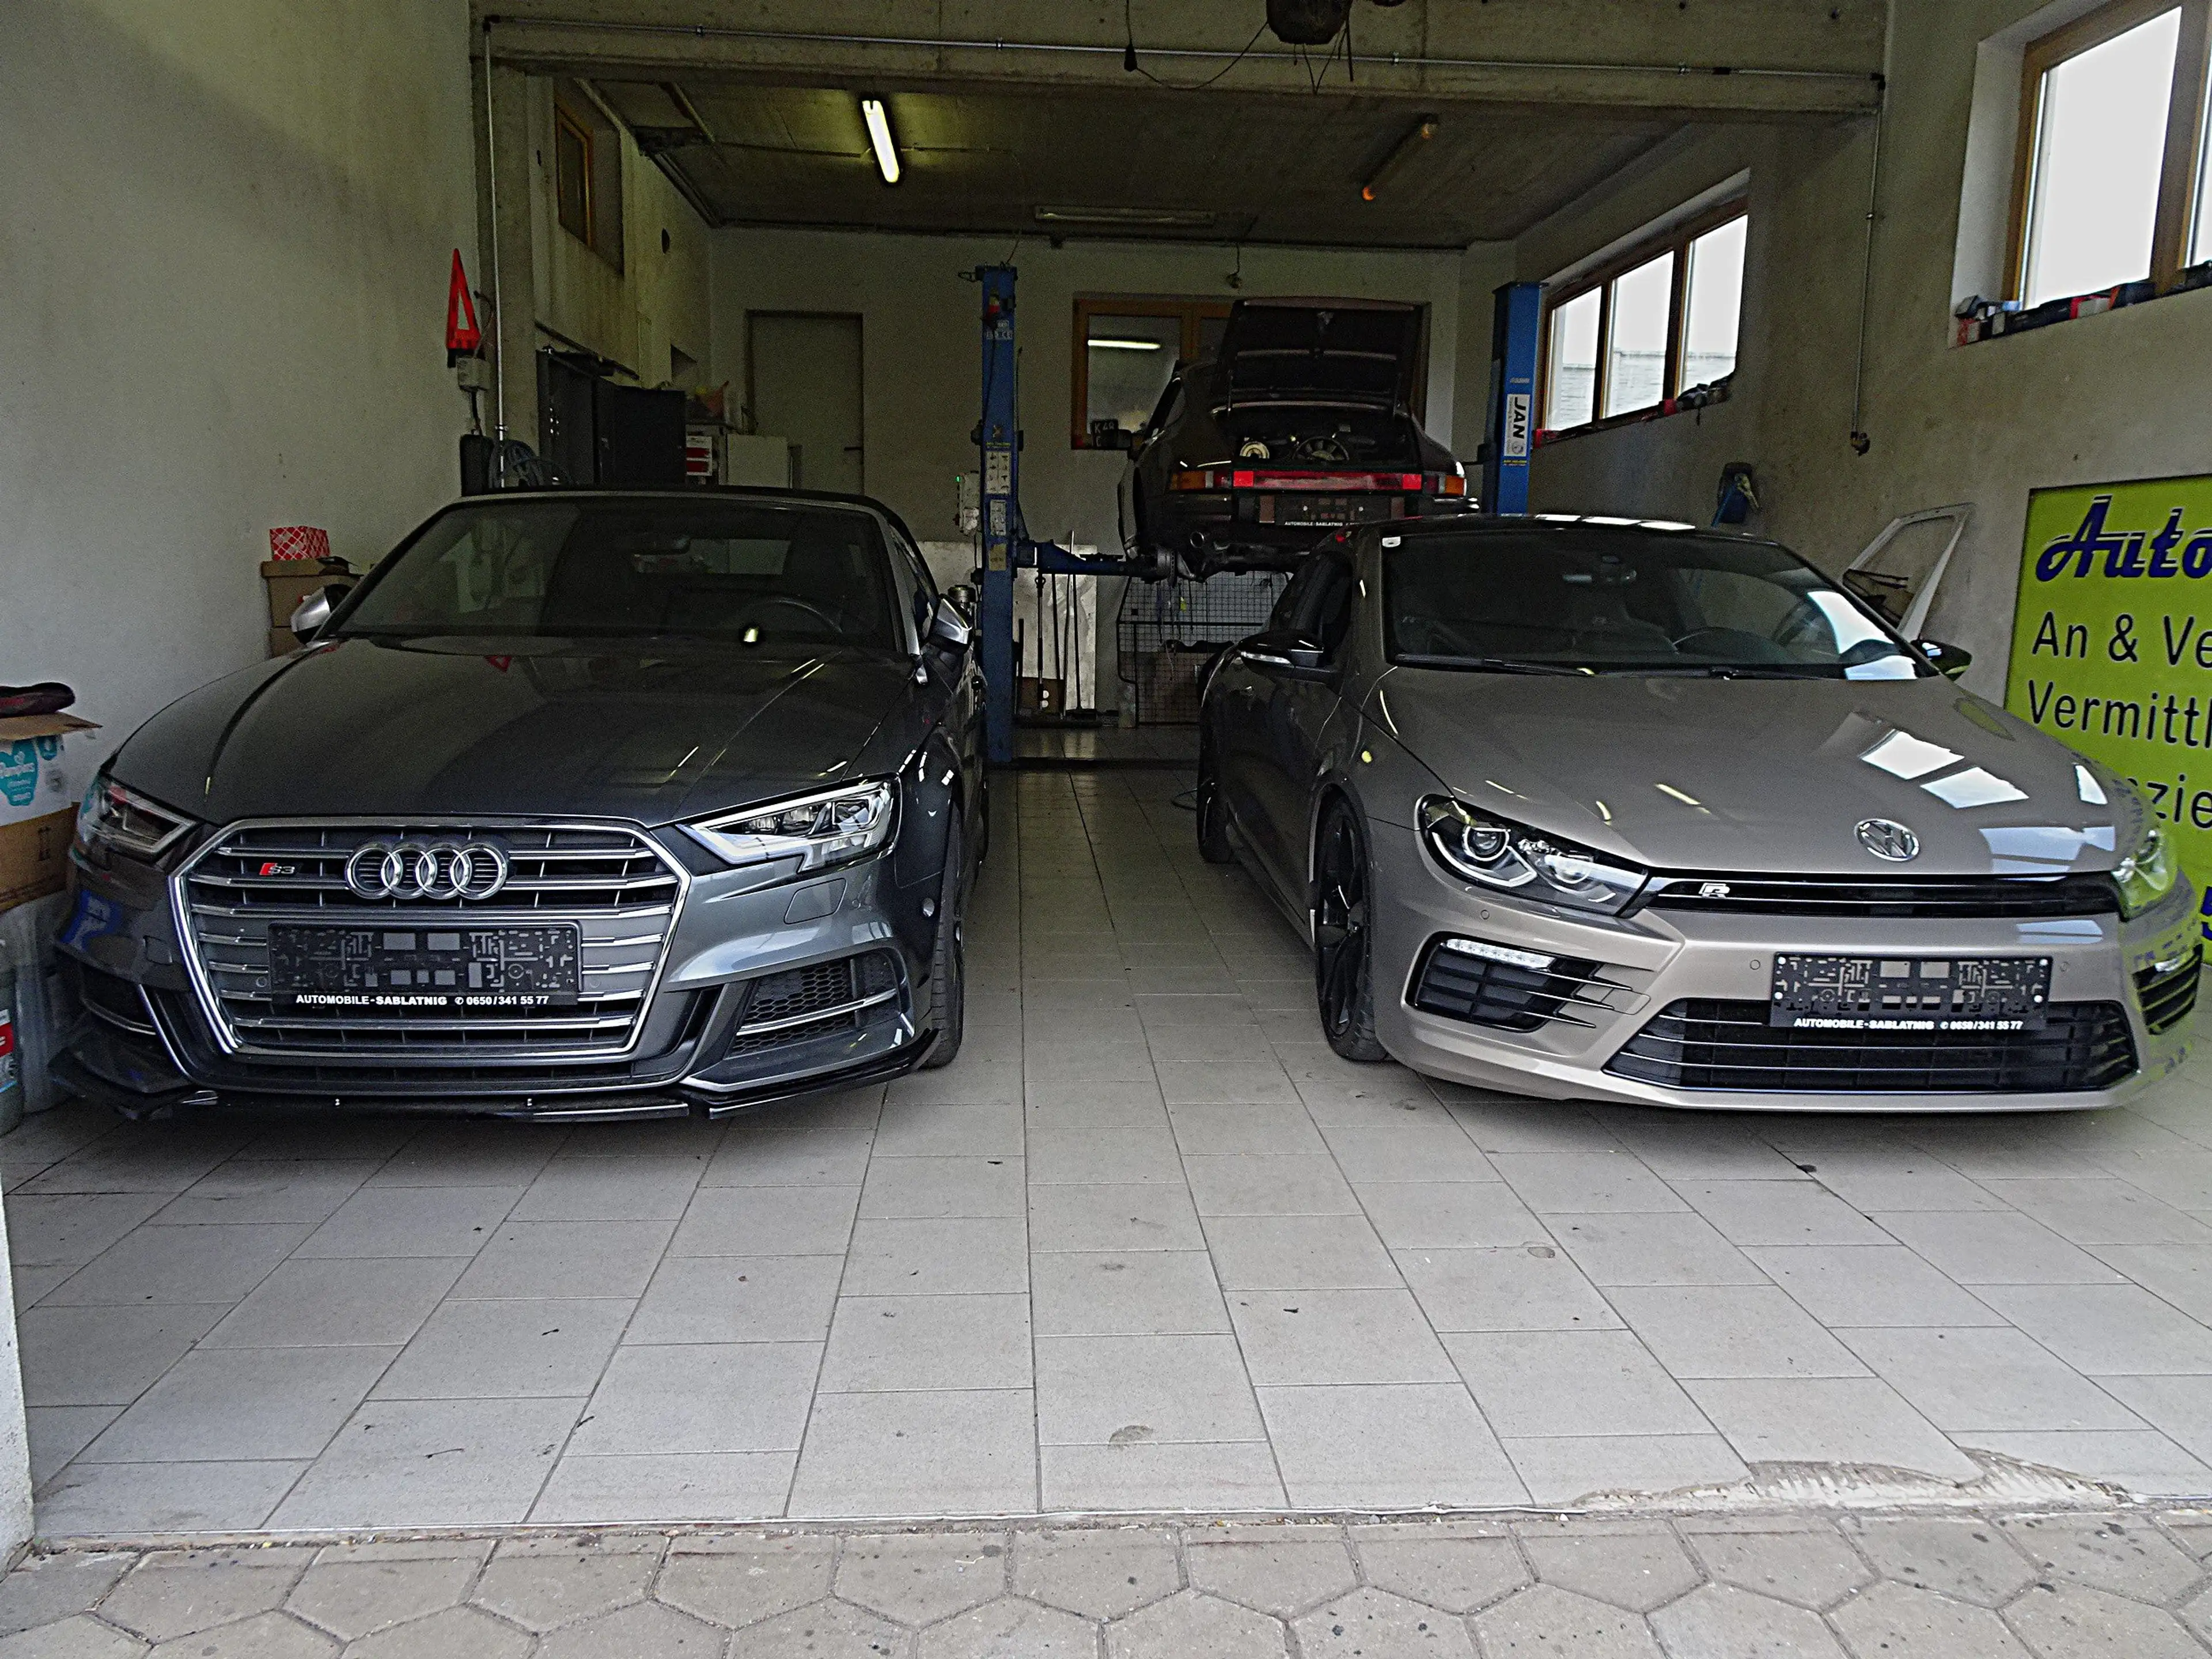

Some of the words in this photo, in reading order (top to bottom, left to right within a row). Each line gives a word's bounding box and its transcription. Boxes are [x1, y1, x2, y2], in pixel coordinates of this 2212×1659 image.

[1513, 397, 1527, 439] JAN
[2036, 493, 2212, 582] Auto
[2032, 611, 2088, 658] An
[2108, 613, 2138, 663] &
[2164, 615, 2212, 669] Ve
[1699, 882, 1730, 899] R
[466, 996, 517, 1005] 0650/341
[520, 996, 534, 1005] 55
[536, 995, 549, 1005] 77
